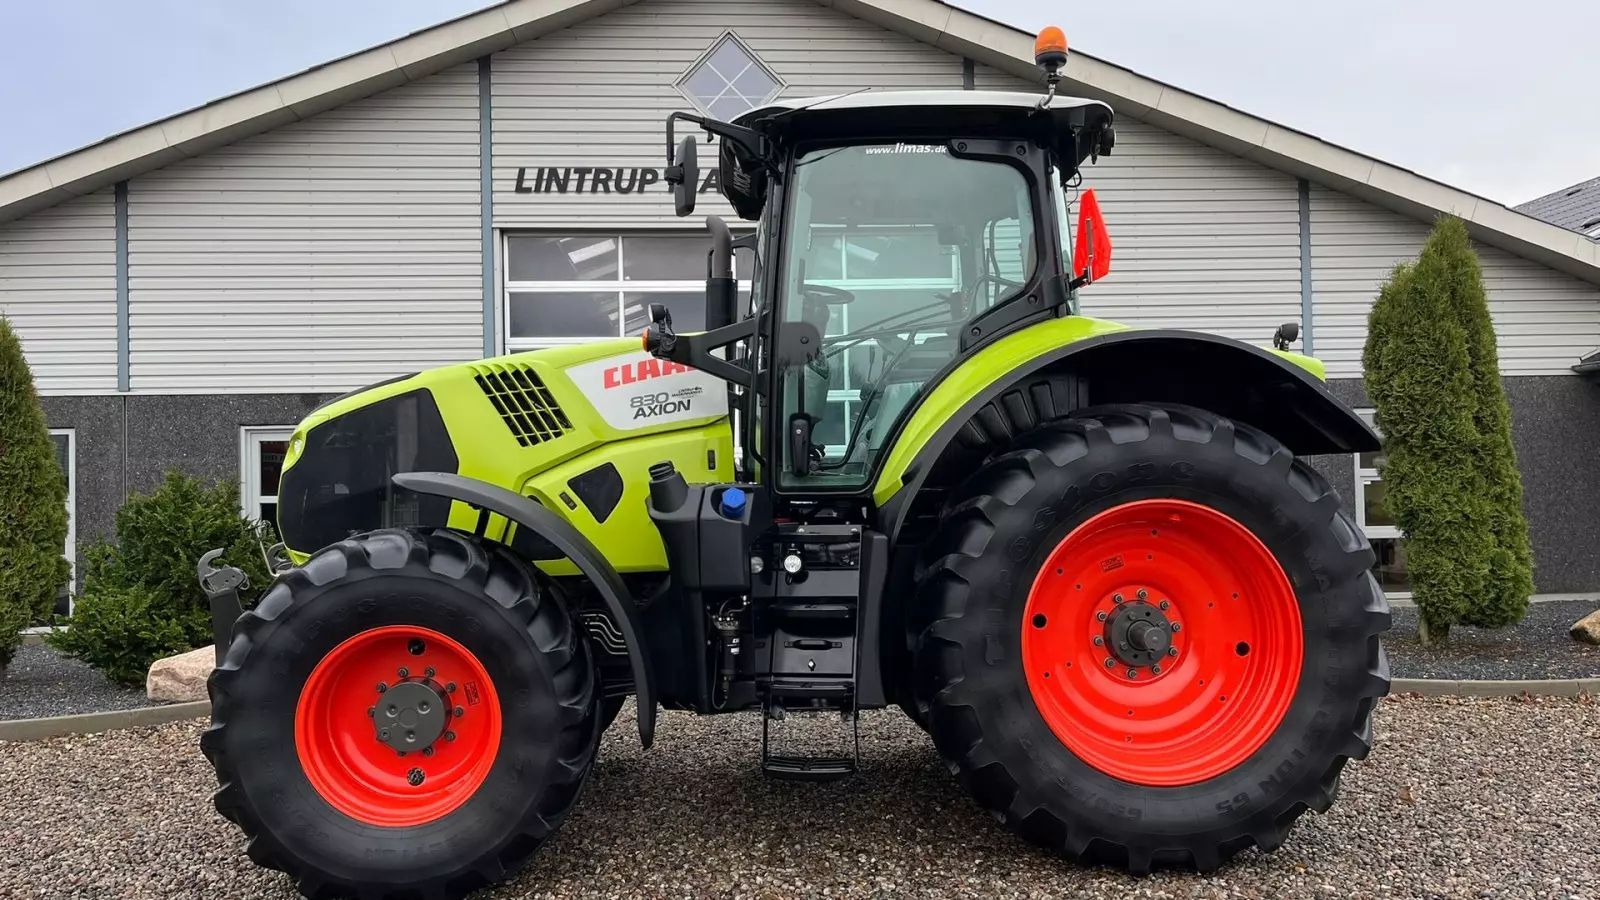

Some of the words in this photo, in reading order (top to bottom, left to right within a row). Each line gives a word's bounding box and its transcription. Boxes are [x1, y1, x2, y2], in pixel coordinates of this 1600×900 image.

[865, 142, 947, 155] www.limas.dk
[514, 167, 659, 194] LINTRUP
[603, 358, 697, 389] CLAA
[630, 392, 669, 409] 830
[633, 399, 691, 420] AXION
